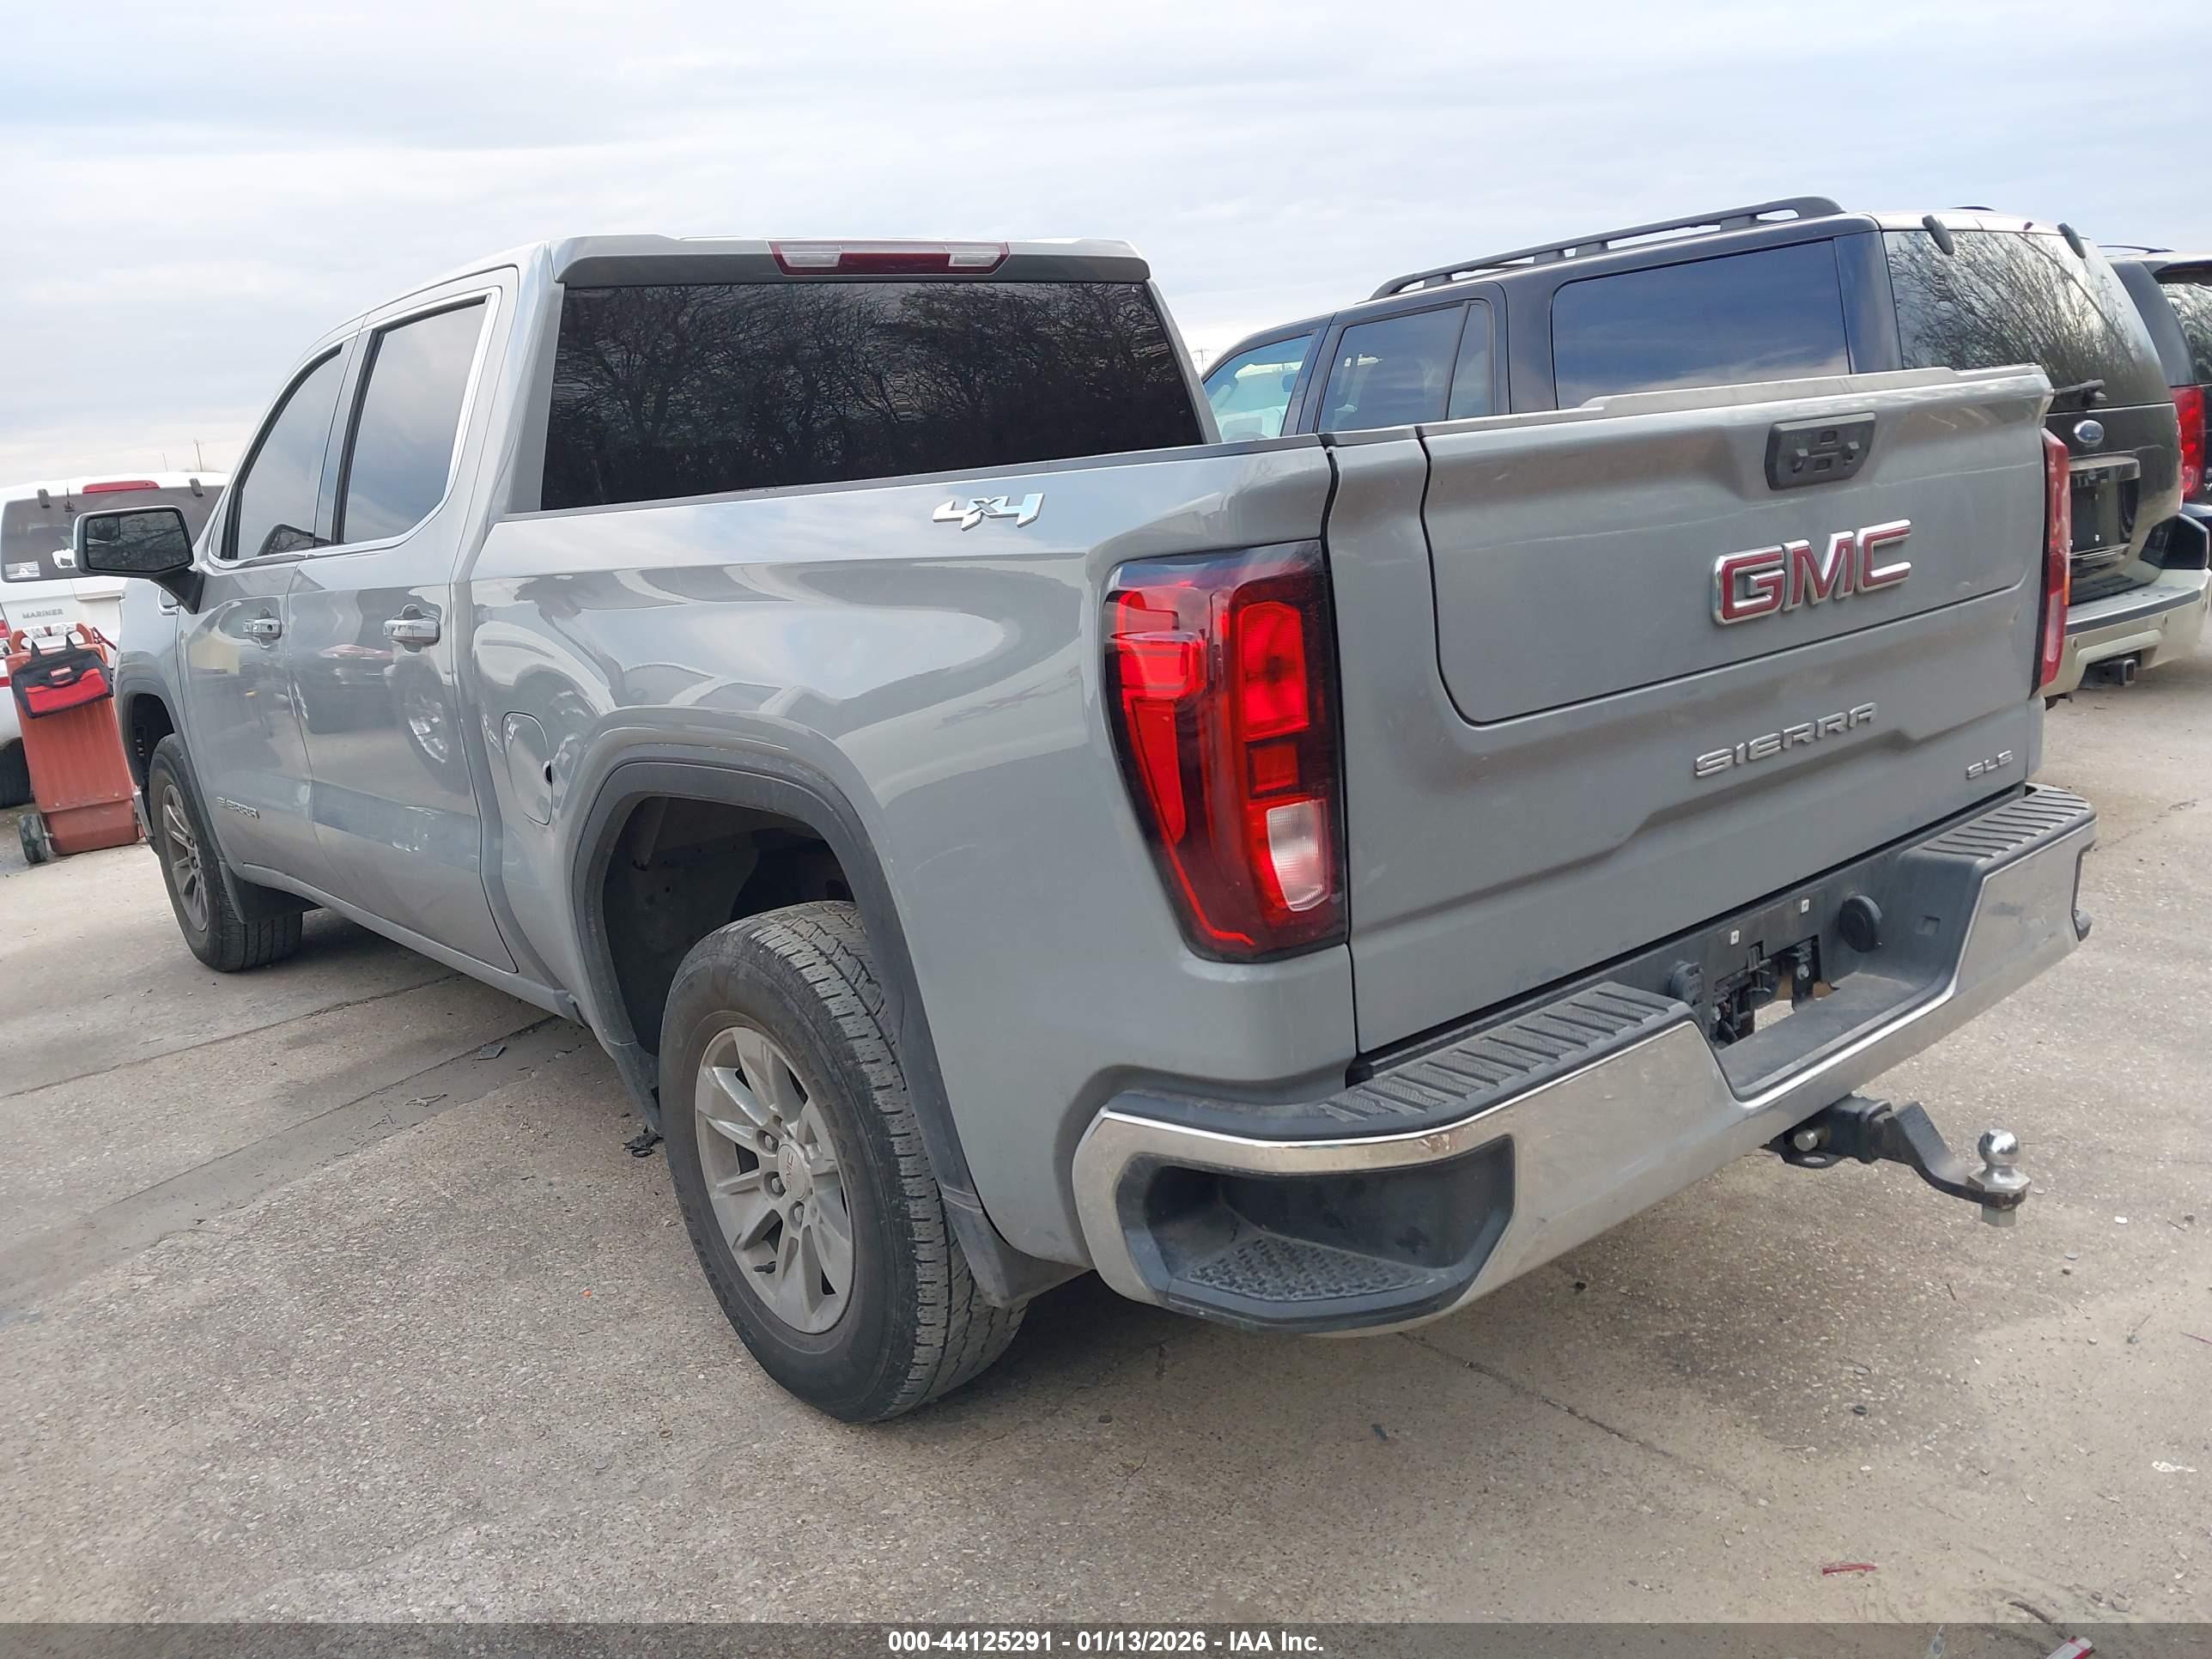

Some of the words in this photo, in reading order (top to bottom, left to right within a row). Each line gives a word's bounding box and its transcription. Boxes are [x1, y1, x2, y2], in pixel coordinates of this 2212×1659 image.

[1711, 519, 1912, 626] GMC
[22, 608, 64, 619] MARINER
[1695, 701, 1878, 778] SIERRA
